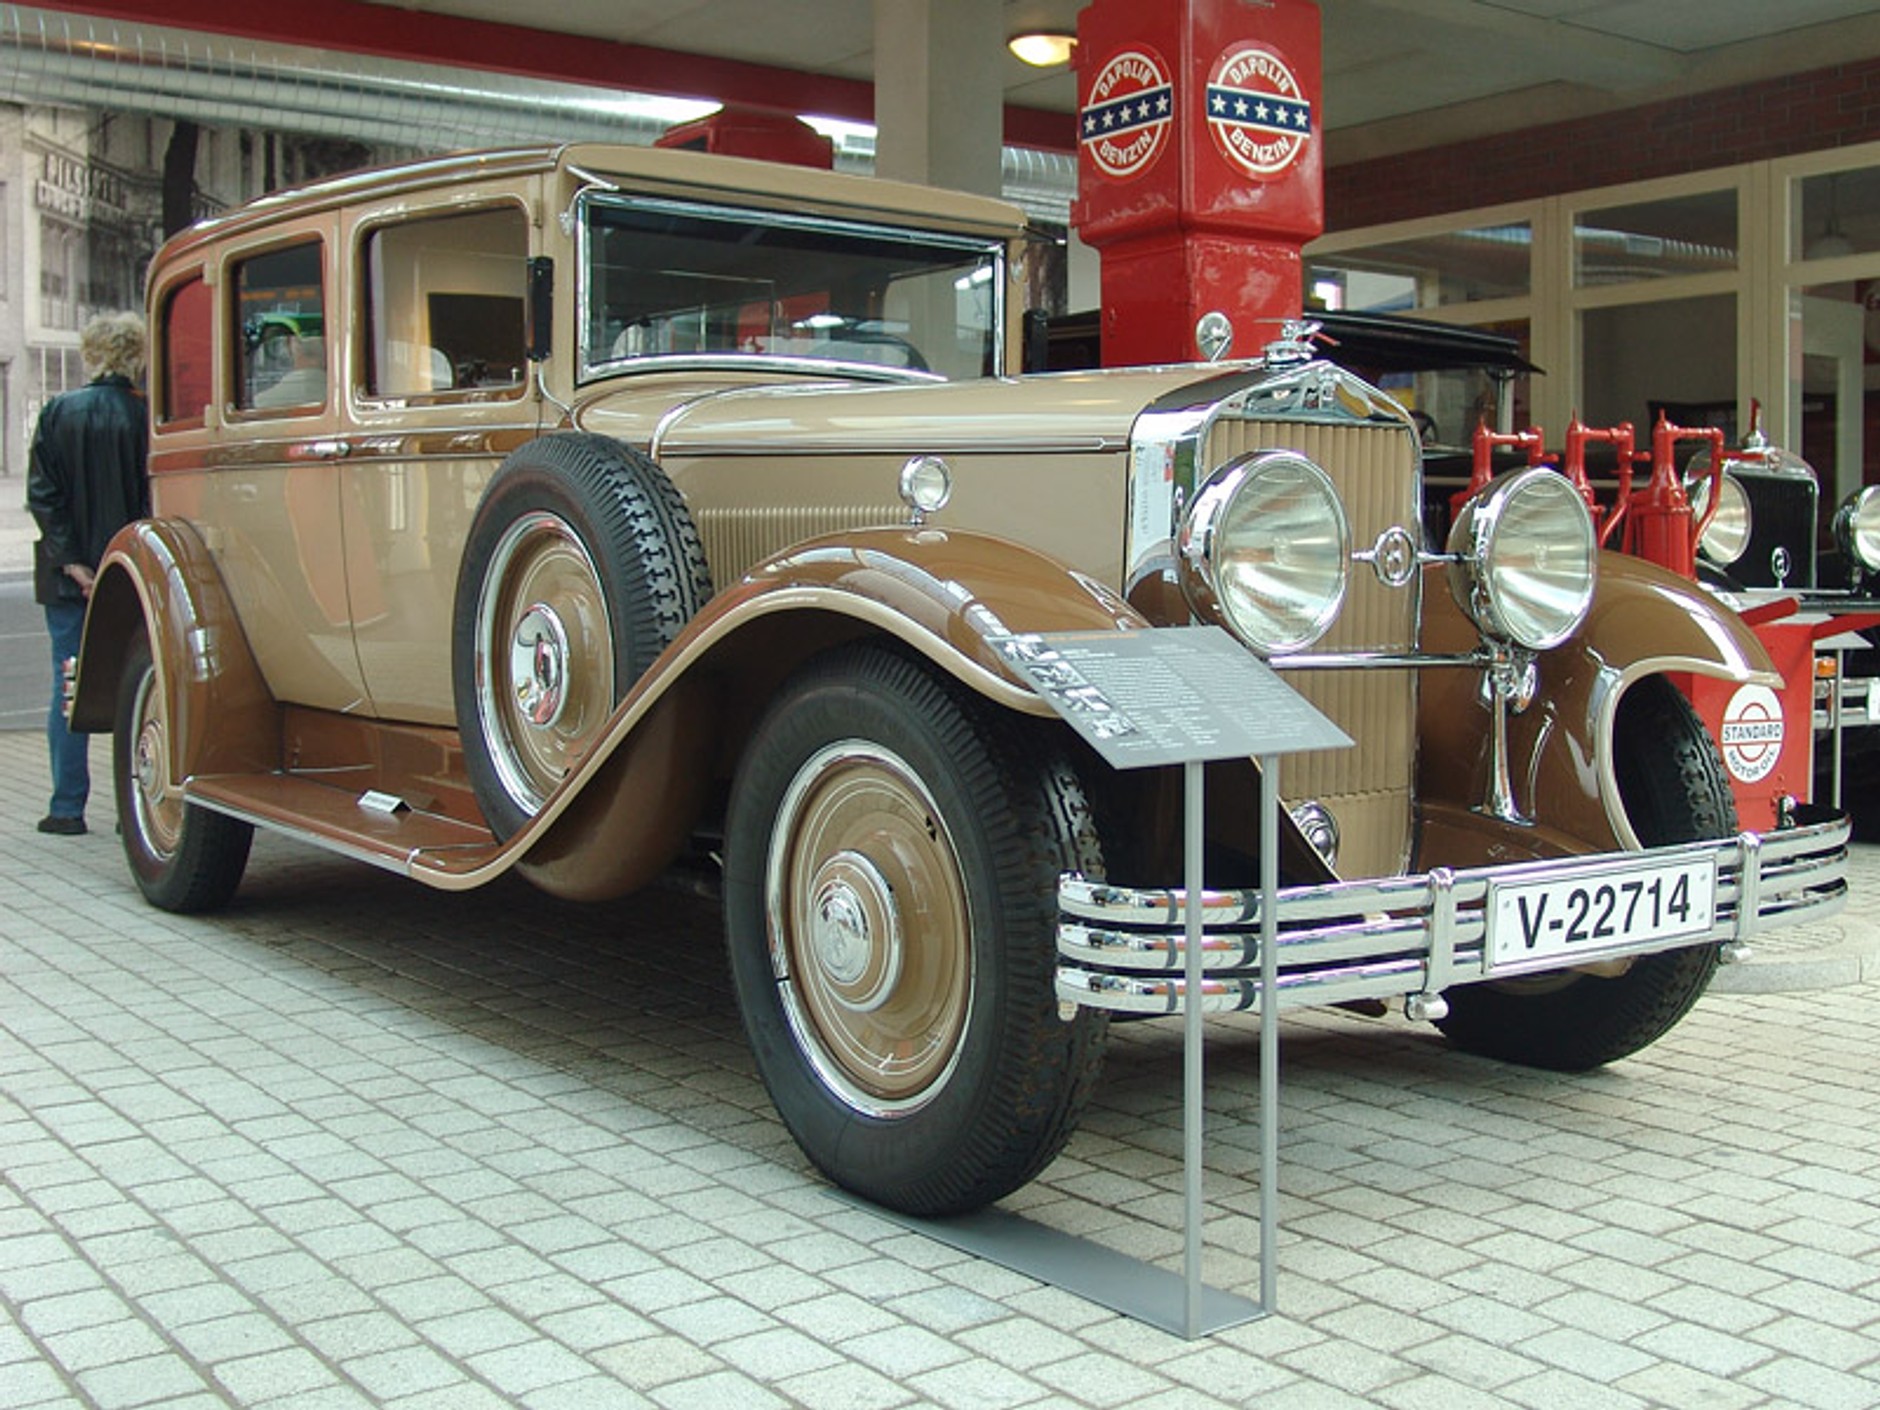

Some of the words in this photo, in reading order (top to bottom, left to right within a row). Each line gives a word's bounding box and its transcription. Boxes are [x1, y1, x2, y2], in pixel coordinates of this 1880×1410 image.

[1099, 60, 1153, 97] DAPOLIN
[1229, 57, 1290, 93] DAPOLIN
[1099, 130, 1153, 165] BENZIN
[1229, 127, 1291, 162] BENZIN
[1724, 723, 1782, 741] STANDARD
[1517, 872, 1691, 949] V-22714
